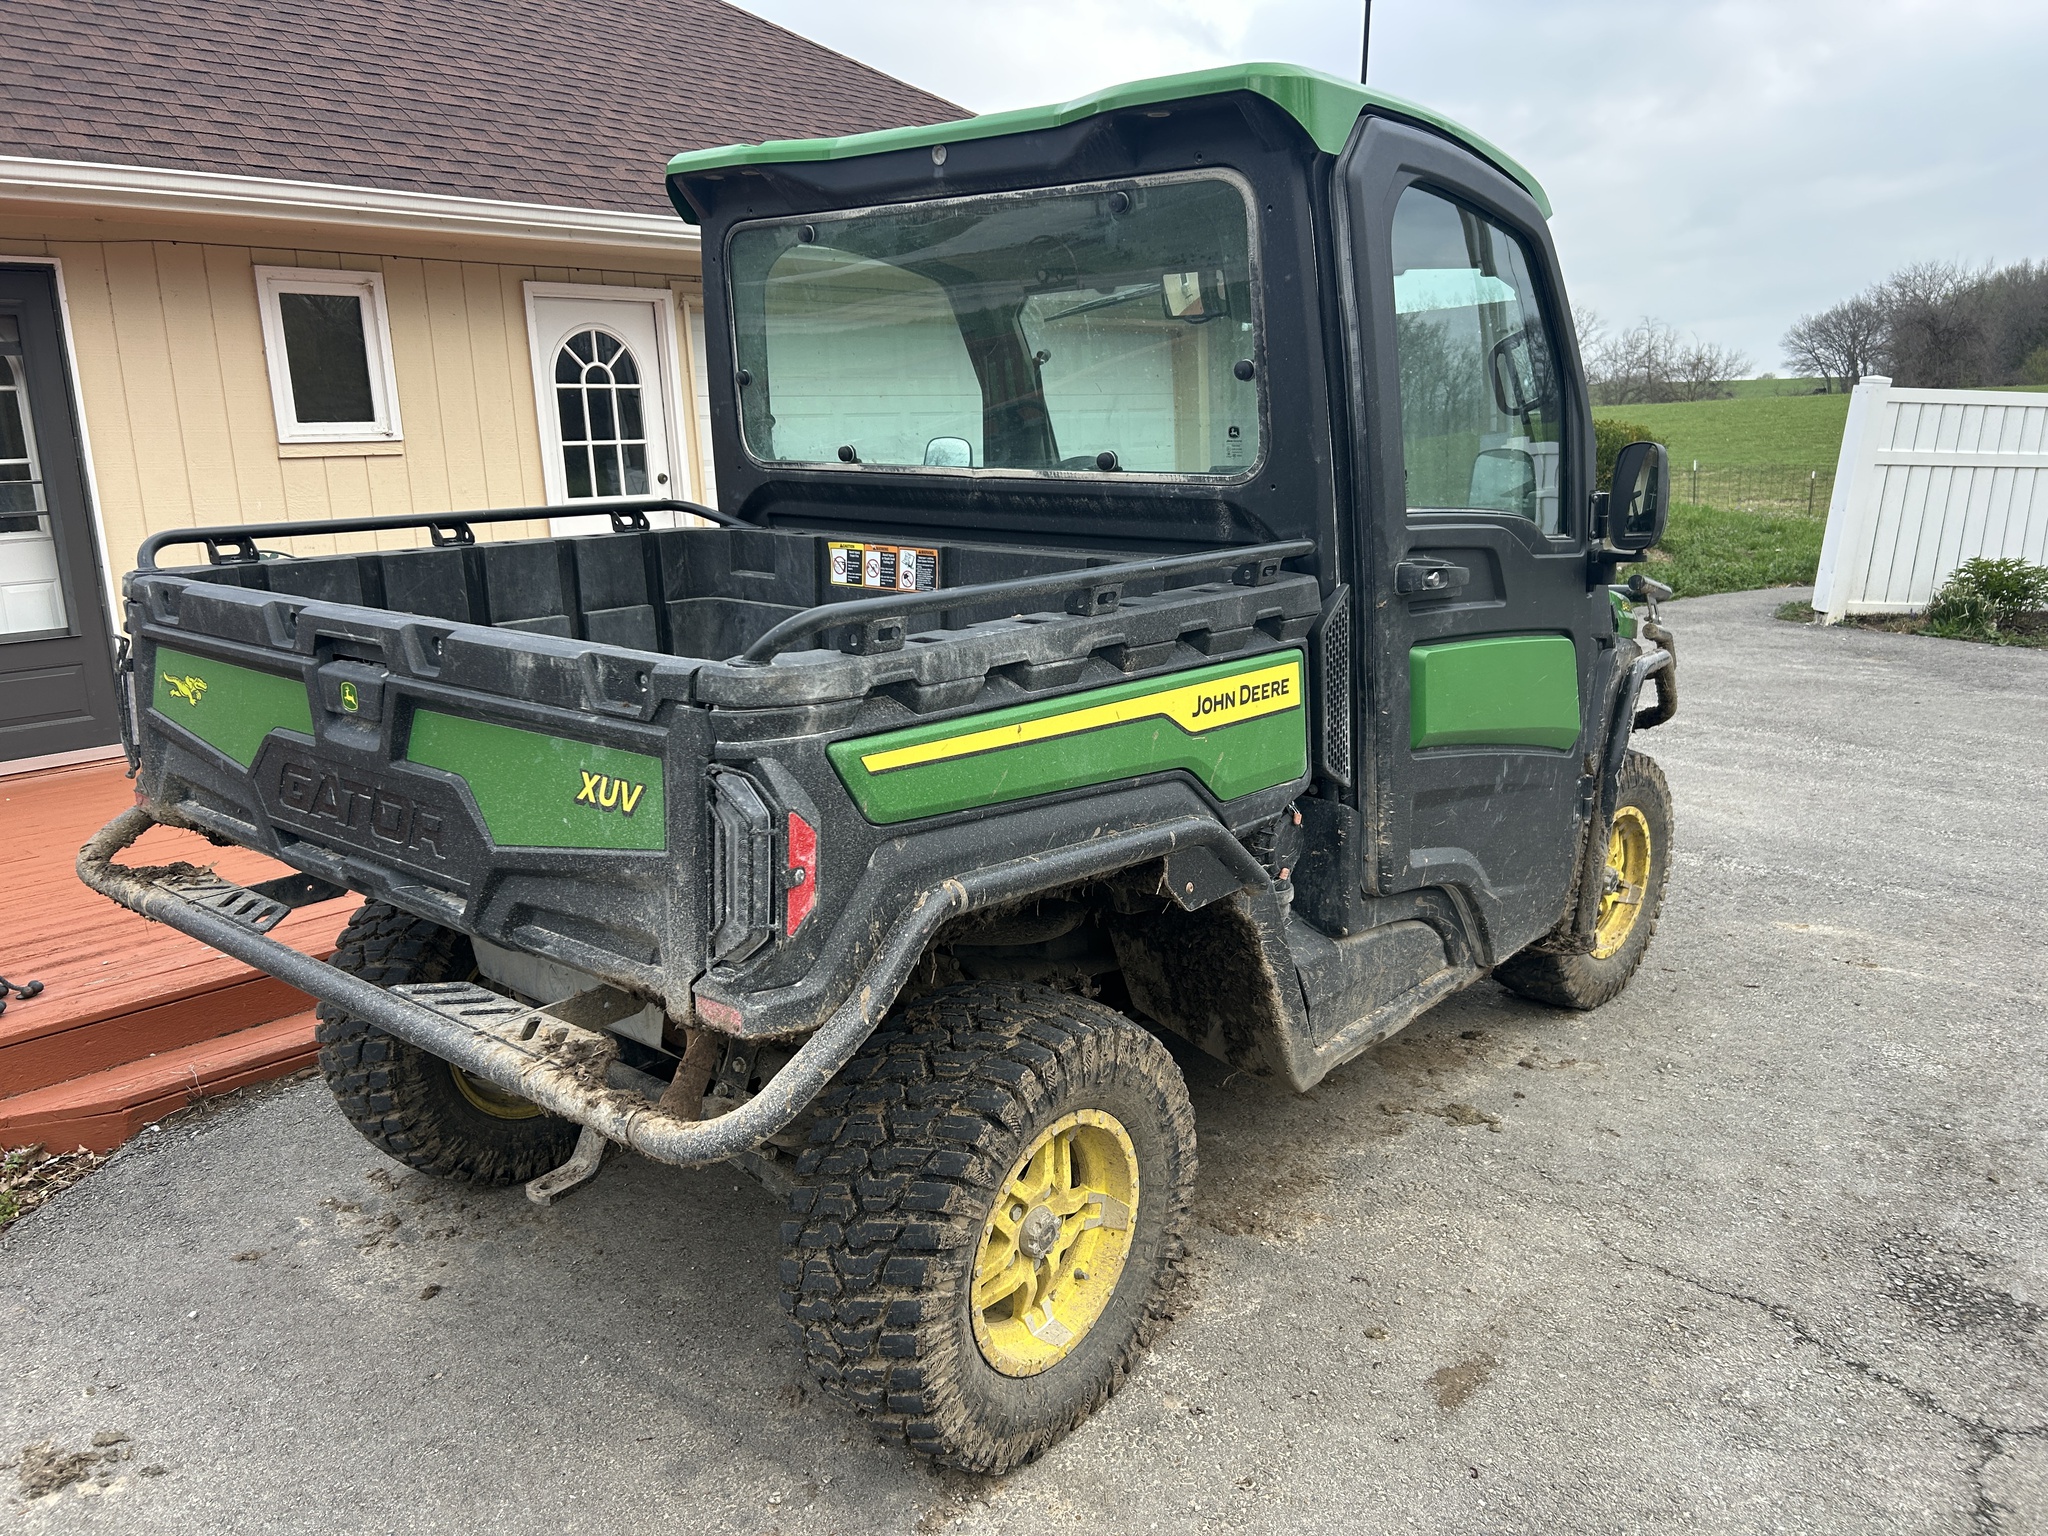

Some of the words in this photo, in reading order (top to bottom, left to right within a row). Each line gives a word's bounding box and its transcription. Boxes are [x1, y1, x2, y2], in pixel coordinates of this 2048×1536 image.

[1191, 691, 1236, 718] JOHN
[1239, 678, 1290, 706] DEERE
[279, 762, 446, 860] GATOR
[574, 769, 647, 818] XUV
